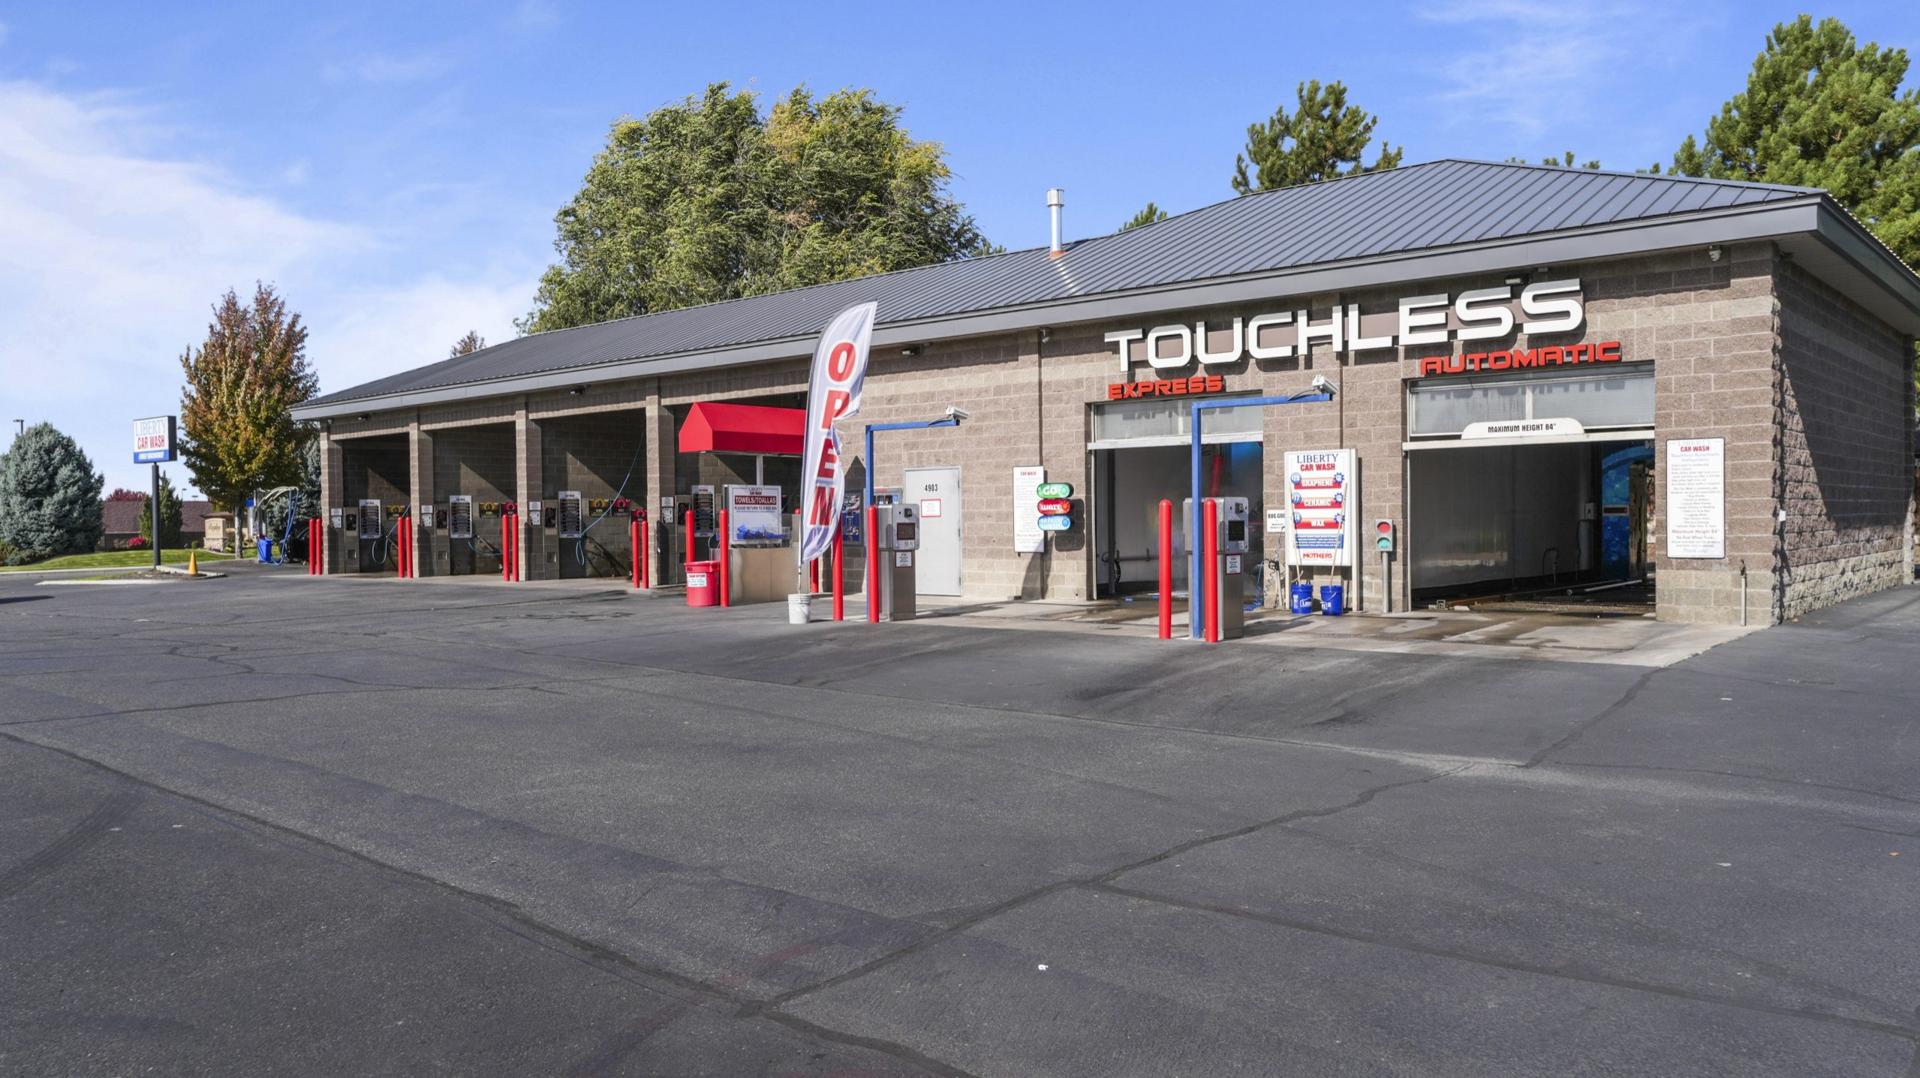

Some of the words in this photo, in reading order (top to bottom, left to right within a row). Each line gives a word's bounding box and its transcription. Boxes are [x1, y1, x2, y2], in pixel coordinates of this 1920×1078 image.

[1104, 278, 1583, 372] TOUCHLESS
[1420, 341, 1621, 375] AUTOMATIC
[1108, 375, 1224, 399] EXPRESS
[810, 342, 857, 526] OPEN
[1487, 424, 1520, 433] MAXIMUM
[1521, 423, 1544, 432] HEIGHT
[138, 436, 149, 449] CAR
[149, 434, 165, 448] WASH
[1296, 453, 1338, 463] LIBERTY
[1315, 463, 1336, 471] WASH
[924, 484, 938, 492] 4903
[1302, 552, 1333, 560] MOTHERS
